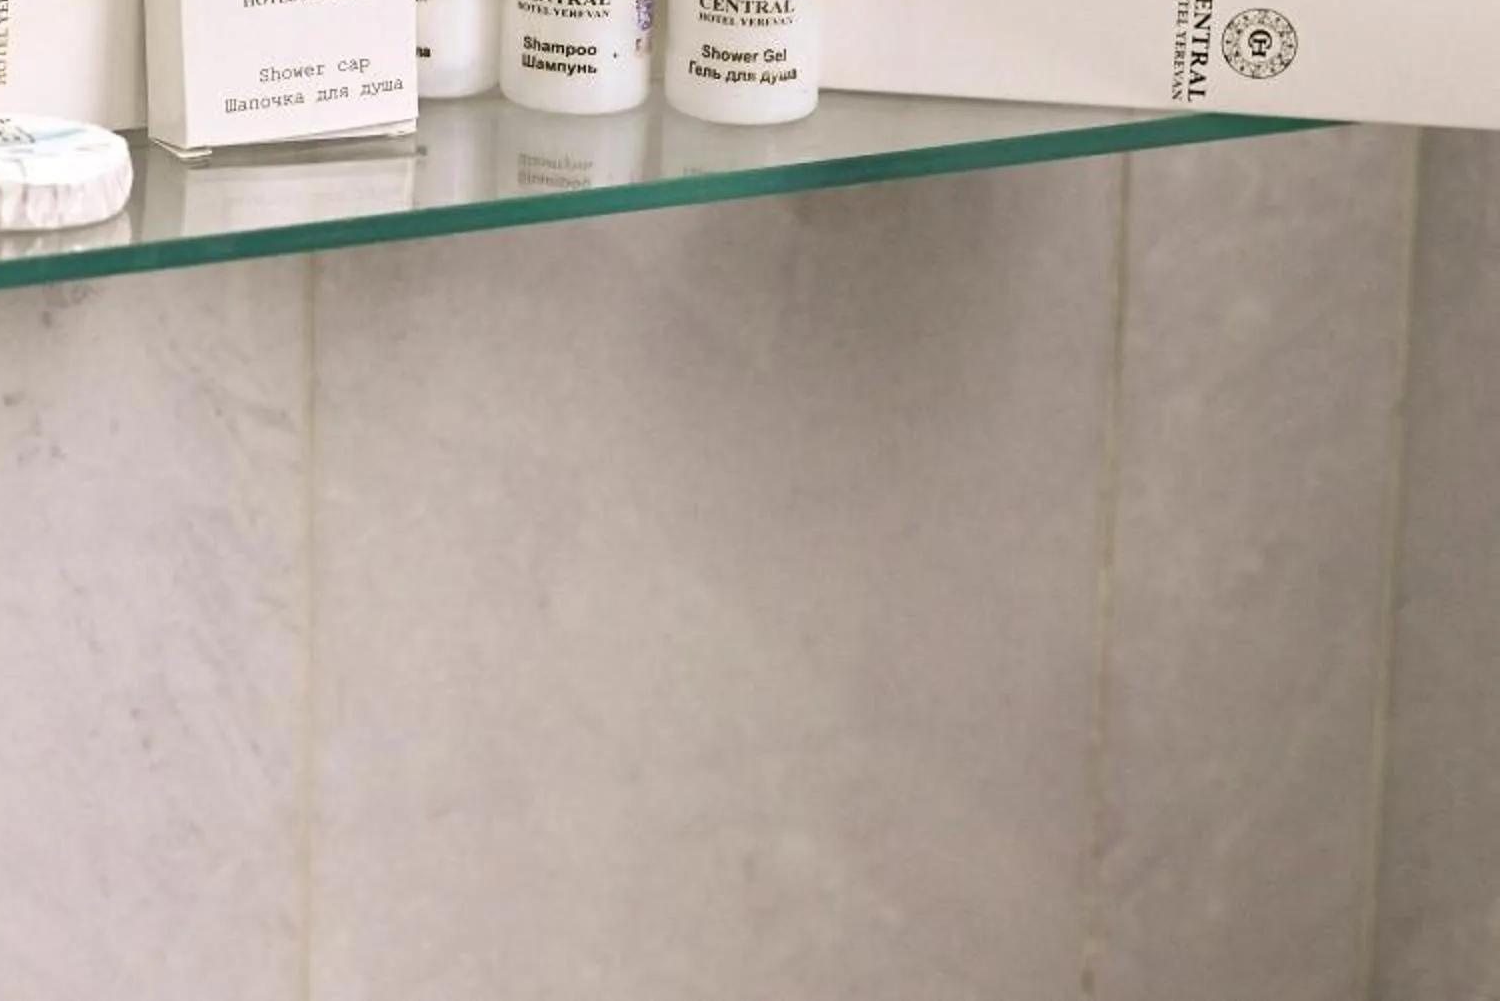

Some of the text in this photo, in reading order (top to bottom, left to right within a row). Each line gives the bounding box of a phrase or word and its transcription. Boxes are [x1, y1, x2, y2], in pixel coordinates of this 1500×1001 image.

[553, 7, 610, 18] YEREVAN
[523, 35, 597, 58] Shampoo
[702, 44, 787, 63] Shower Gel
[259, 58, 371, 83] Shower cap
[522, 53, 598, 76] Шампунь
[688, 59, 722, 80] Гель
[725, 70, 757, 83] для
[1171, 30, 1187, 101] YEREVAN
[225, 78, 404, 114] Шапочка для душа
